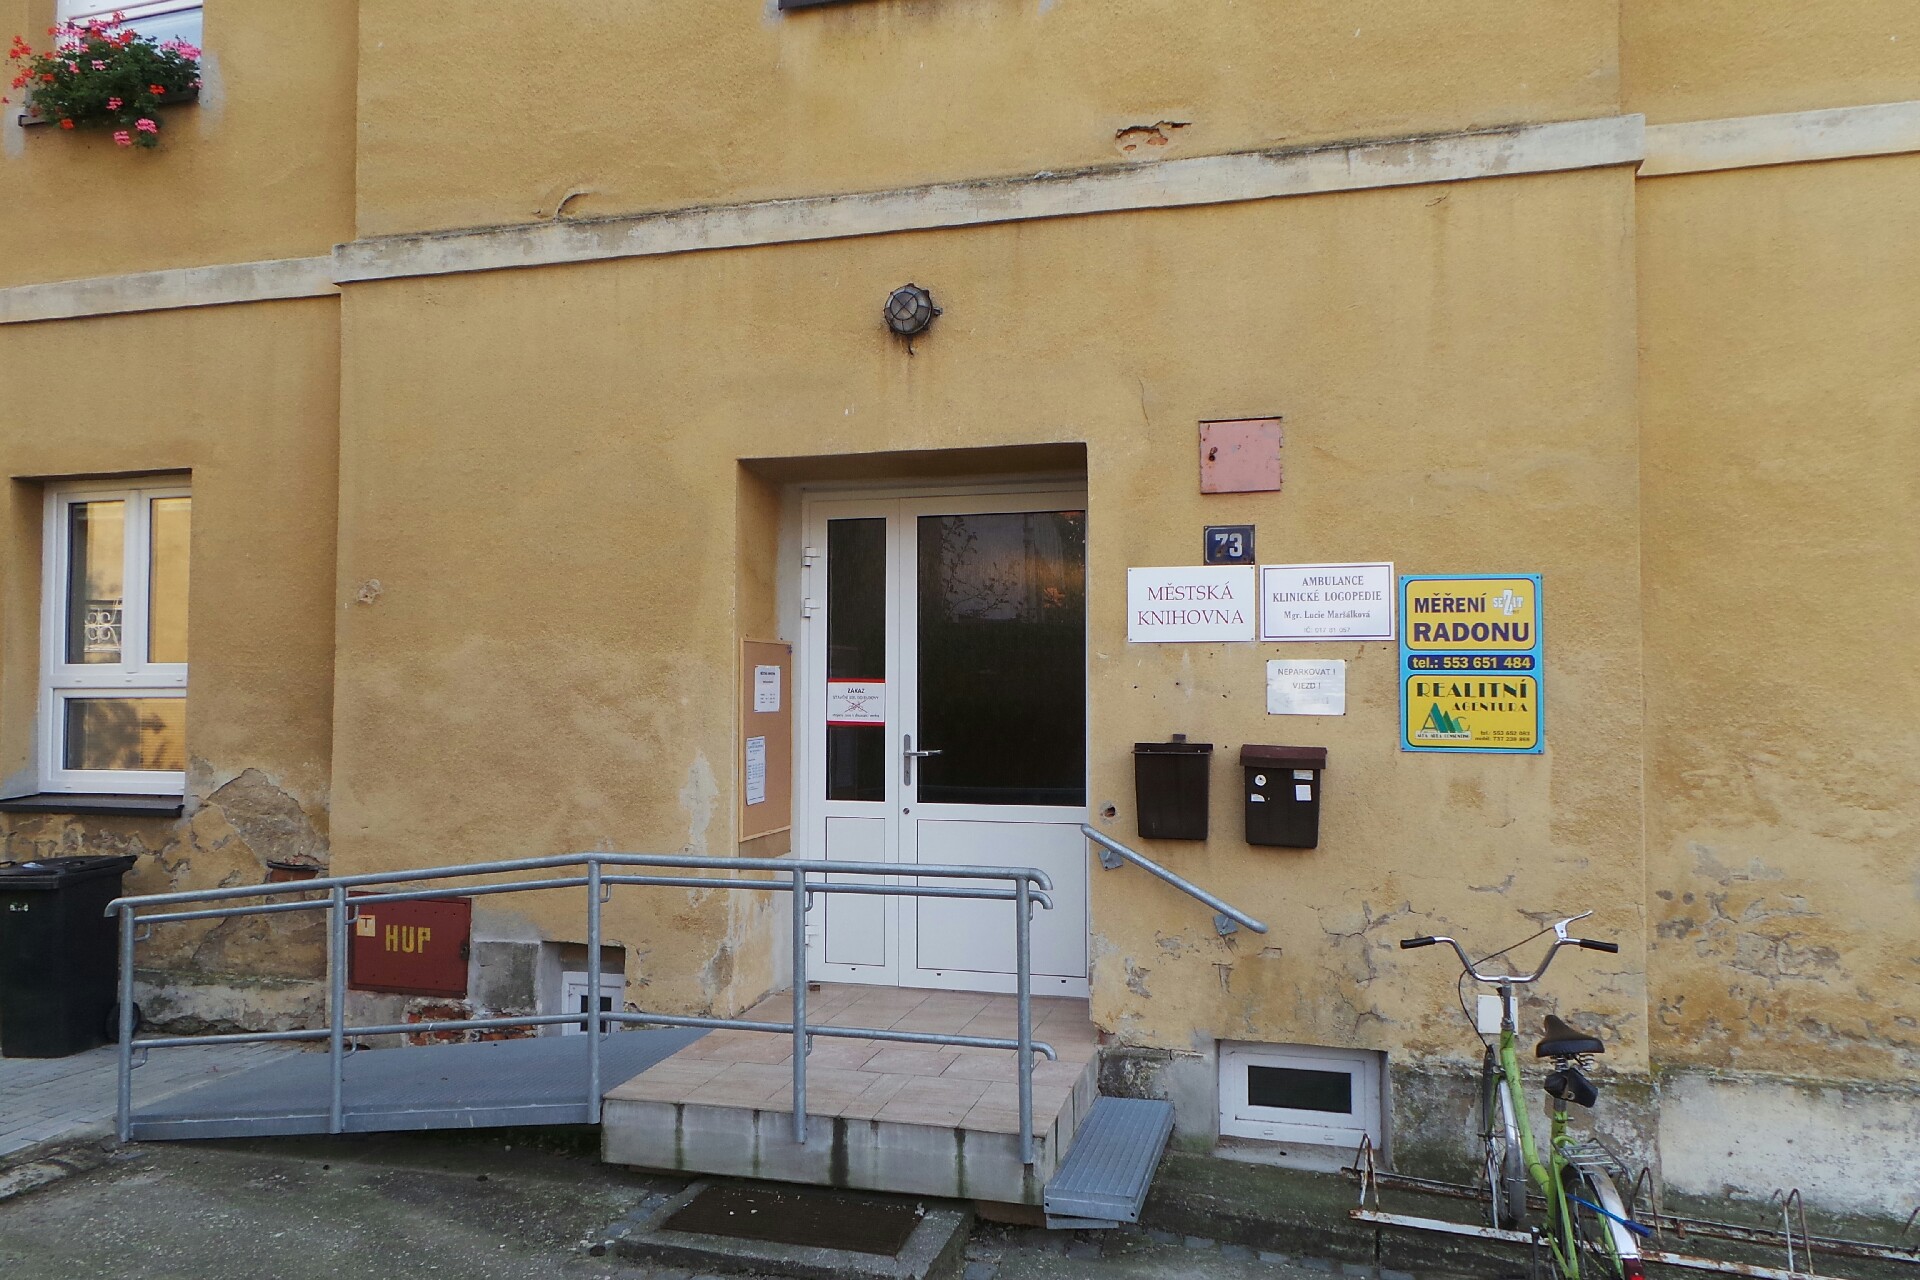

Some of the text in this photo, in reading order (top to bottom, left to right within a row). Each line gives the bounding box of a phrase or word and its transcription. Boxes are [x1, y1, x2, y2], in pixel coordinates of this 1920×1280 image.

[1214, 533, 1243, 558] 73
[1302, 575, 1364, 587] AMBULANCE
[1147, 581, 1234, 601] MĚSTSKÁ
[1272, 589, 1382, 602] KLINICKÉ LOGOPEDIE
[1414, 592, 1487, 614] MĚŘENÍ
[1137, 609, 1244, 626] KNIHOVNA
[1284, 609, 1371, 620] Mgr. Lucie Maršálková
[1413, 622, 1529, 642] RADONU
[1412, 657, 1531, 669] tel.: 553 651 484
[1277, 668, 1331, 676] NEPARKOVAT
[1416, 679, 1527, 699] REALITNÍ
[1452, 702, 1528, 712] AGENTURA
[385, 924, 431, 954] HUP
